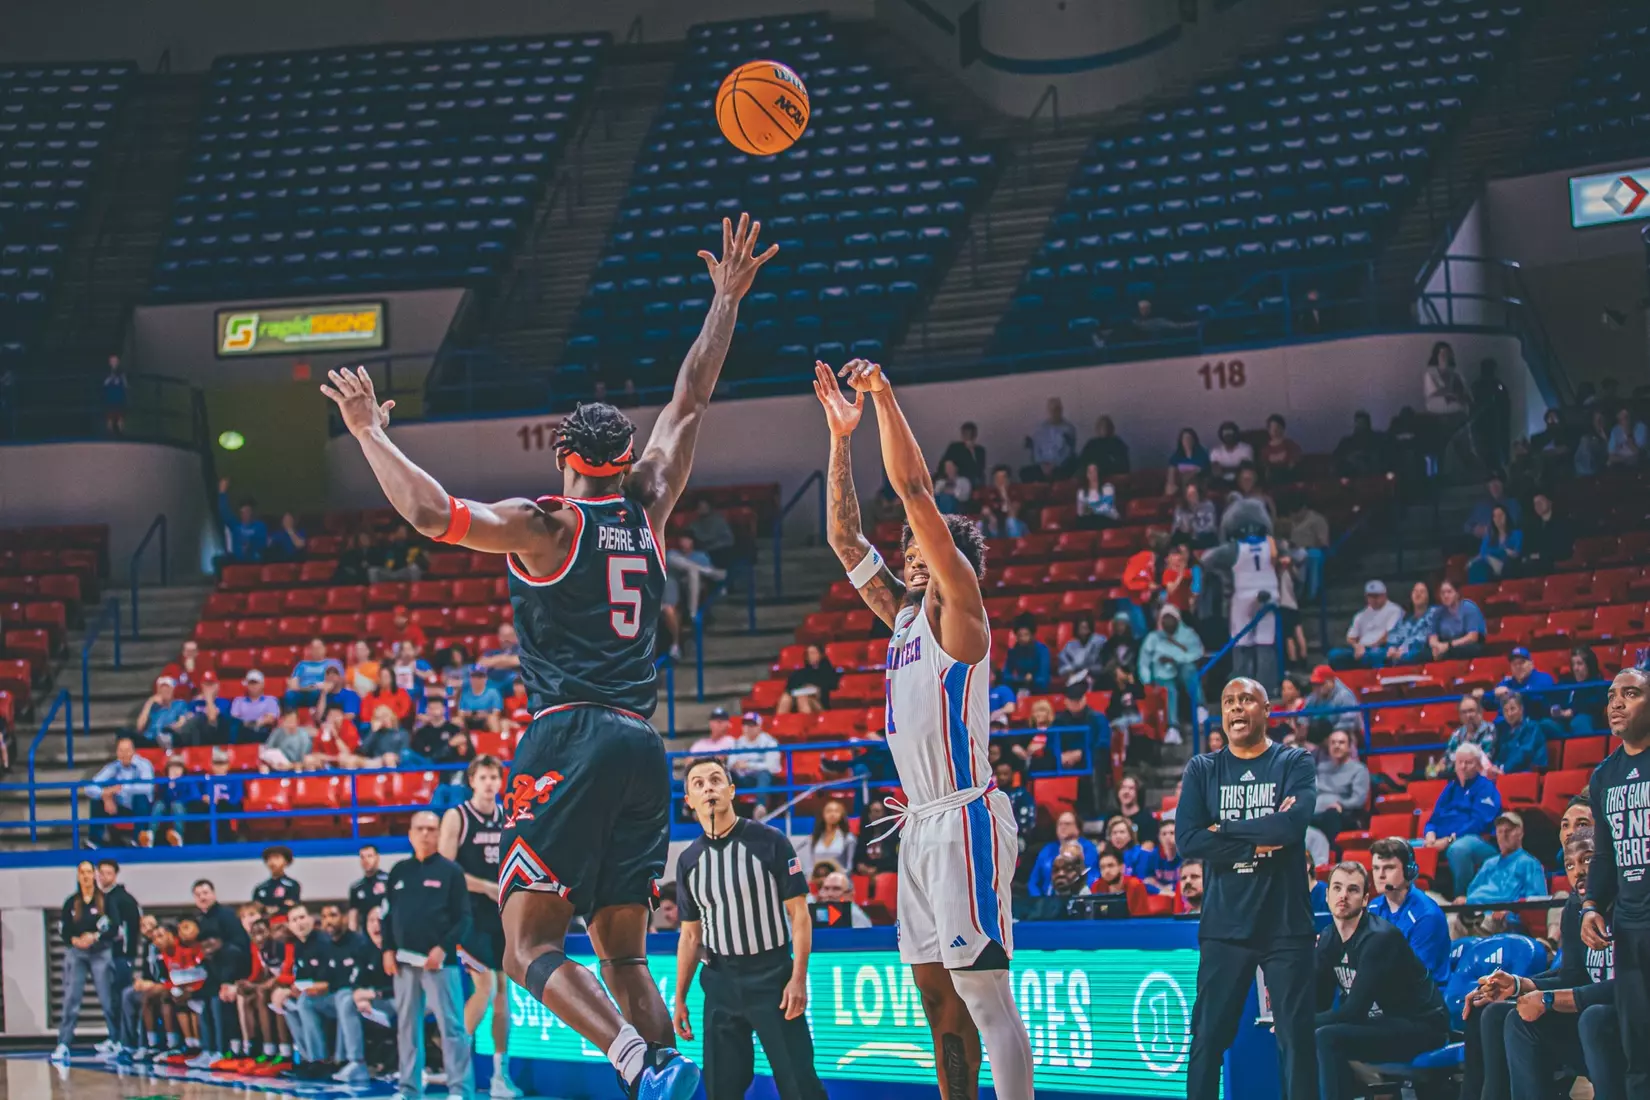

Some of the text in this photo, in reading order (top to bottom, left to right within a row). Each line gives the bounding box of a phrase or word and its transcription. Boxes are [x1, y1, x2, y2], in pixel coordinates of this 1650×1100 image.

[774, 95, 805, 129] NCAA
[1197, 360, 1246, 390] 118
[517, 423, 562, 452] 117
[598, 525, 635, 551] PIERRE
[607, 554, 648, 639] 5
[1220, 783, 1276, 809] THIS GAME
[1606, 785, 1627, 814] THIS
[832, 964, 1093, 1071] LOW CES
